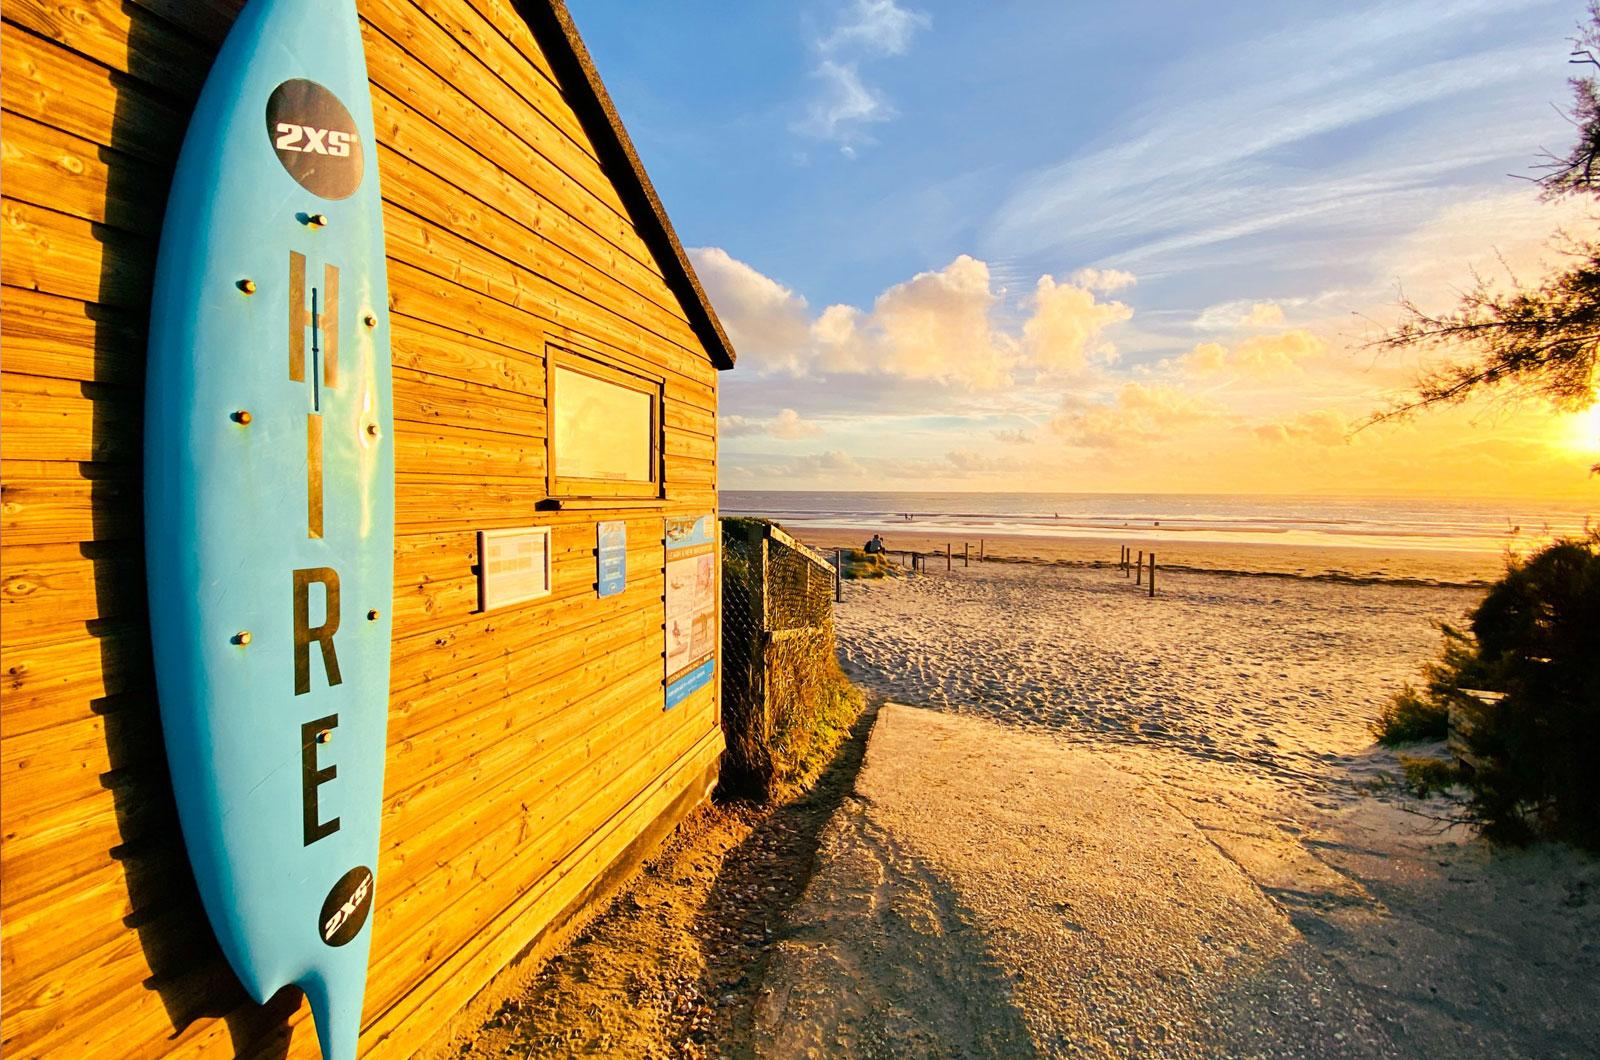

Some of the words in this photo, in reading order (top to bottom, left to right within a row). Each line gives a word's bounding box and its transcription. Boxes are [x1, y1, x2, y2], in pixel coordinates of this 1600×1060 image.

[276, 123, 358, 157] 2XS
[289, 250, 342, 847] HIRE
[325, 872, 371, 940] 2XS
